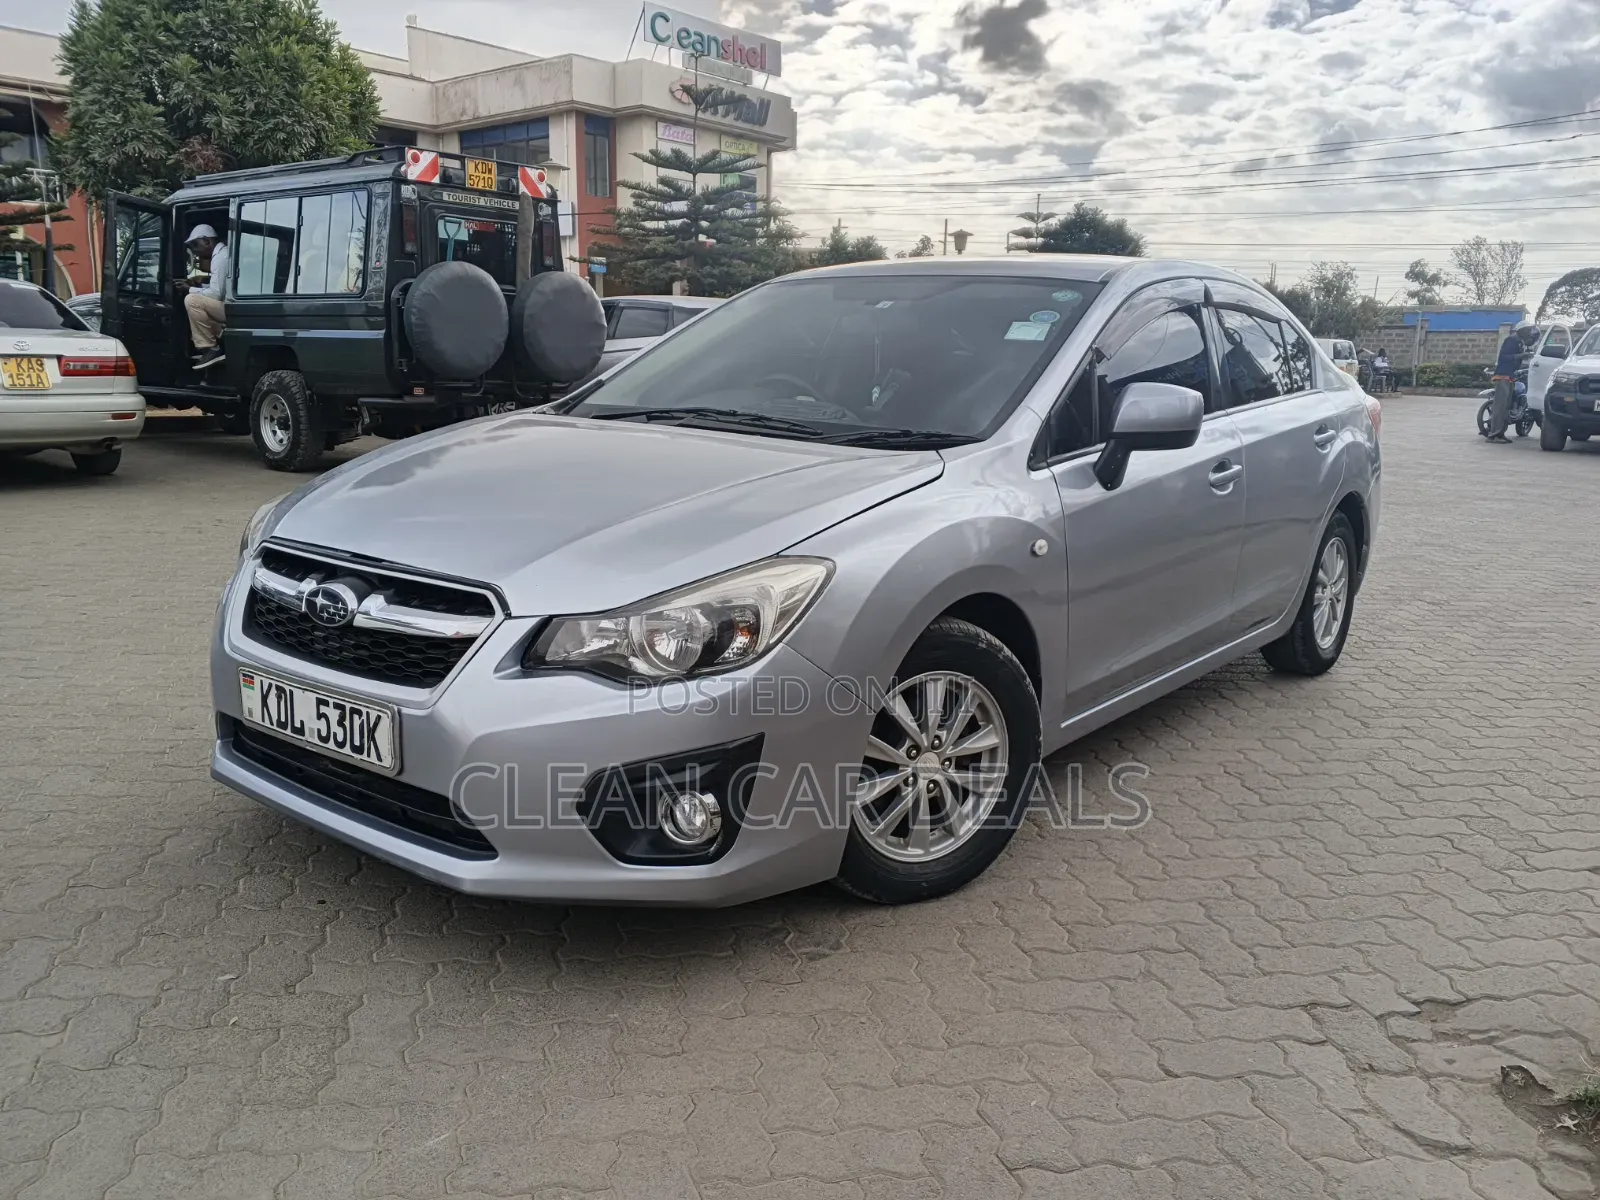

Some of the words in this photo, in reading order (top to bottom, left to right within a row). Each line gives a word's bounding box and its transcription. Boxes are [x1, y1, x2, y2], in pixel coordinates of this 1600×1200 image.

[474, 160, 493, 175] KDW
[468, 175, 494, 189] 571Q
[446, 193, 482, 205] TOURIST
[484, 197, 517, 209] VEHICLE
[8, 373, 45, 387] 151A
[260, 679, 305, 737] KDL
[315, 696, 382, 763] 530K
